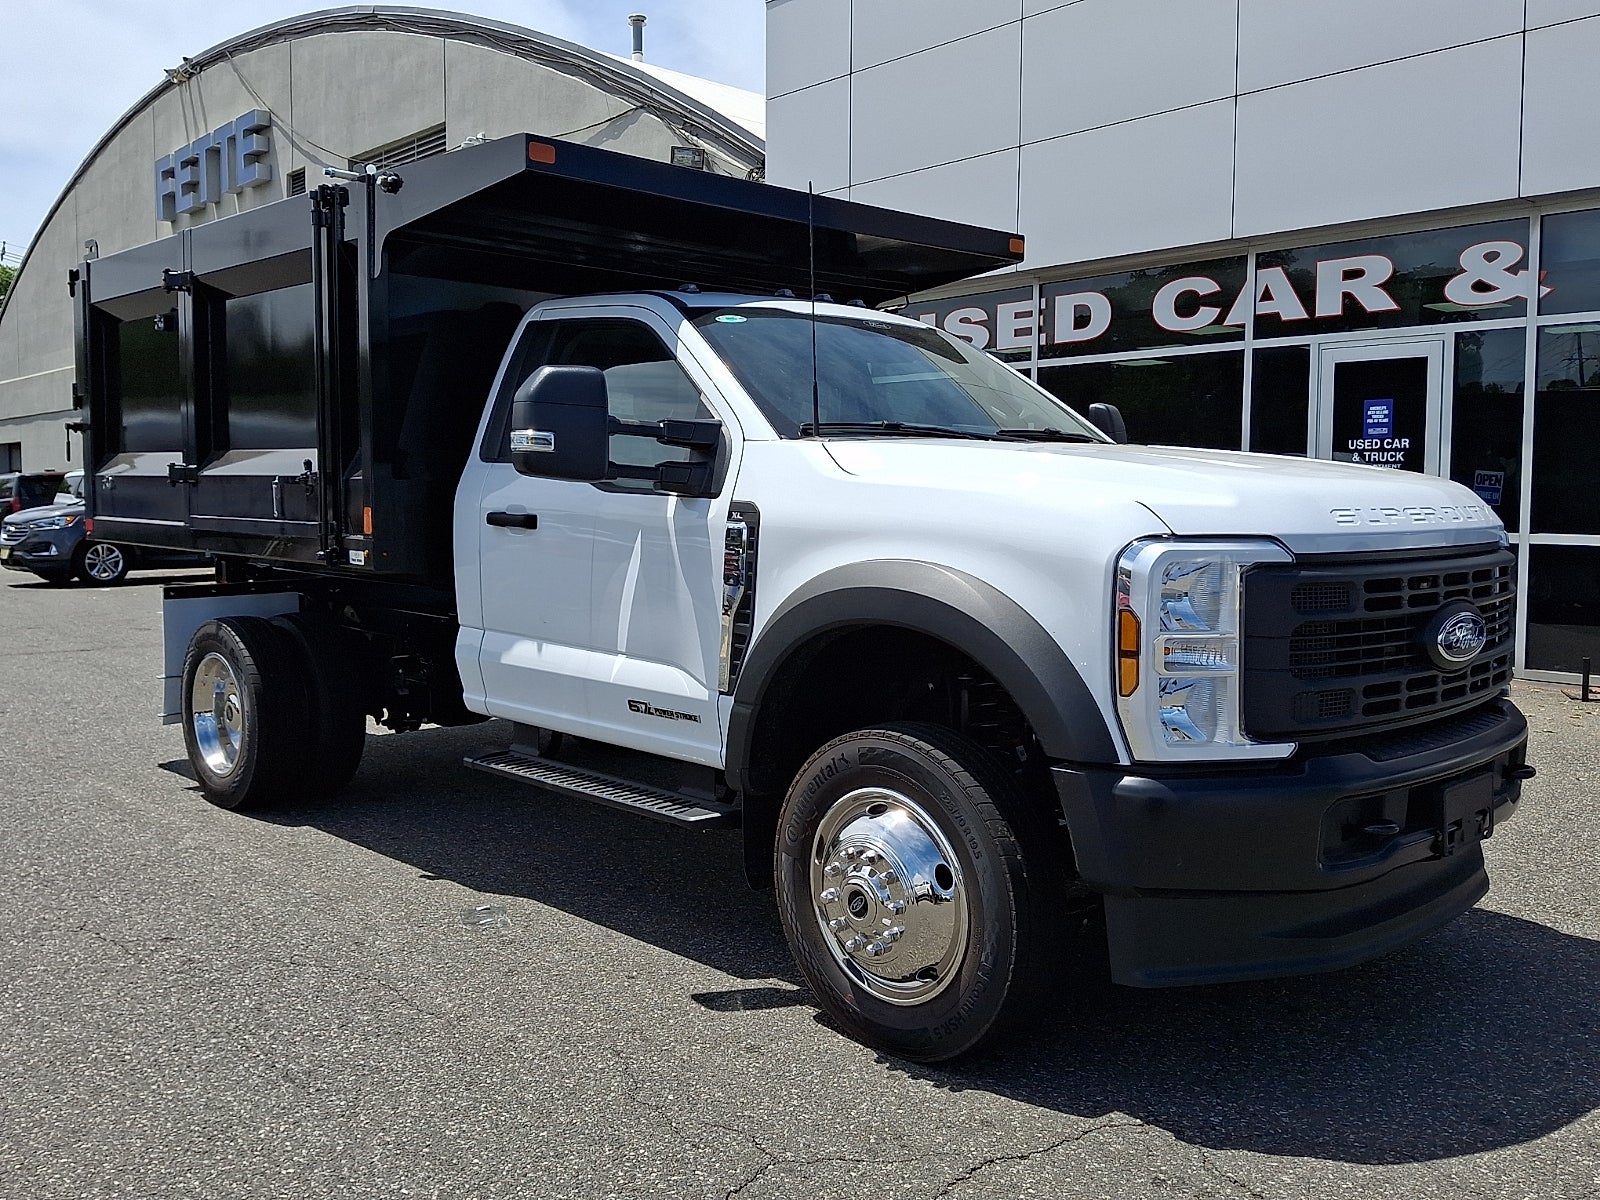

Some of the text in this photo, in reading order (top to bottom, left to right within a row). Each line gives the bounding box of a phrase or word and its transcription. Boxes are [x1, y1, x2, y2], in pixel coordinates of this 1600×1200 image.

[154, 108, 271, 222] FETTE
[1152, 254, 1401, 333] CAR
[1444, 240, 1555, 306] &
[1348, 438, 1410, 450] USED CAR
[1352, 451, 1405, 462] & TRUCK
[1475, 472, 1503, 488] OPEN
[731, 511, 744, 520] XL
[1329, 505, 1445, 527] SUPER
[1444, 620, 1484, 653] Ford
